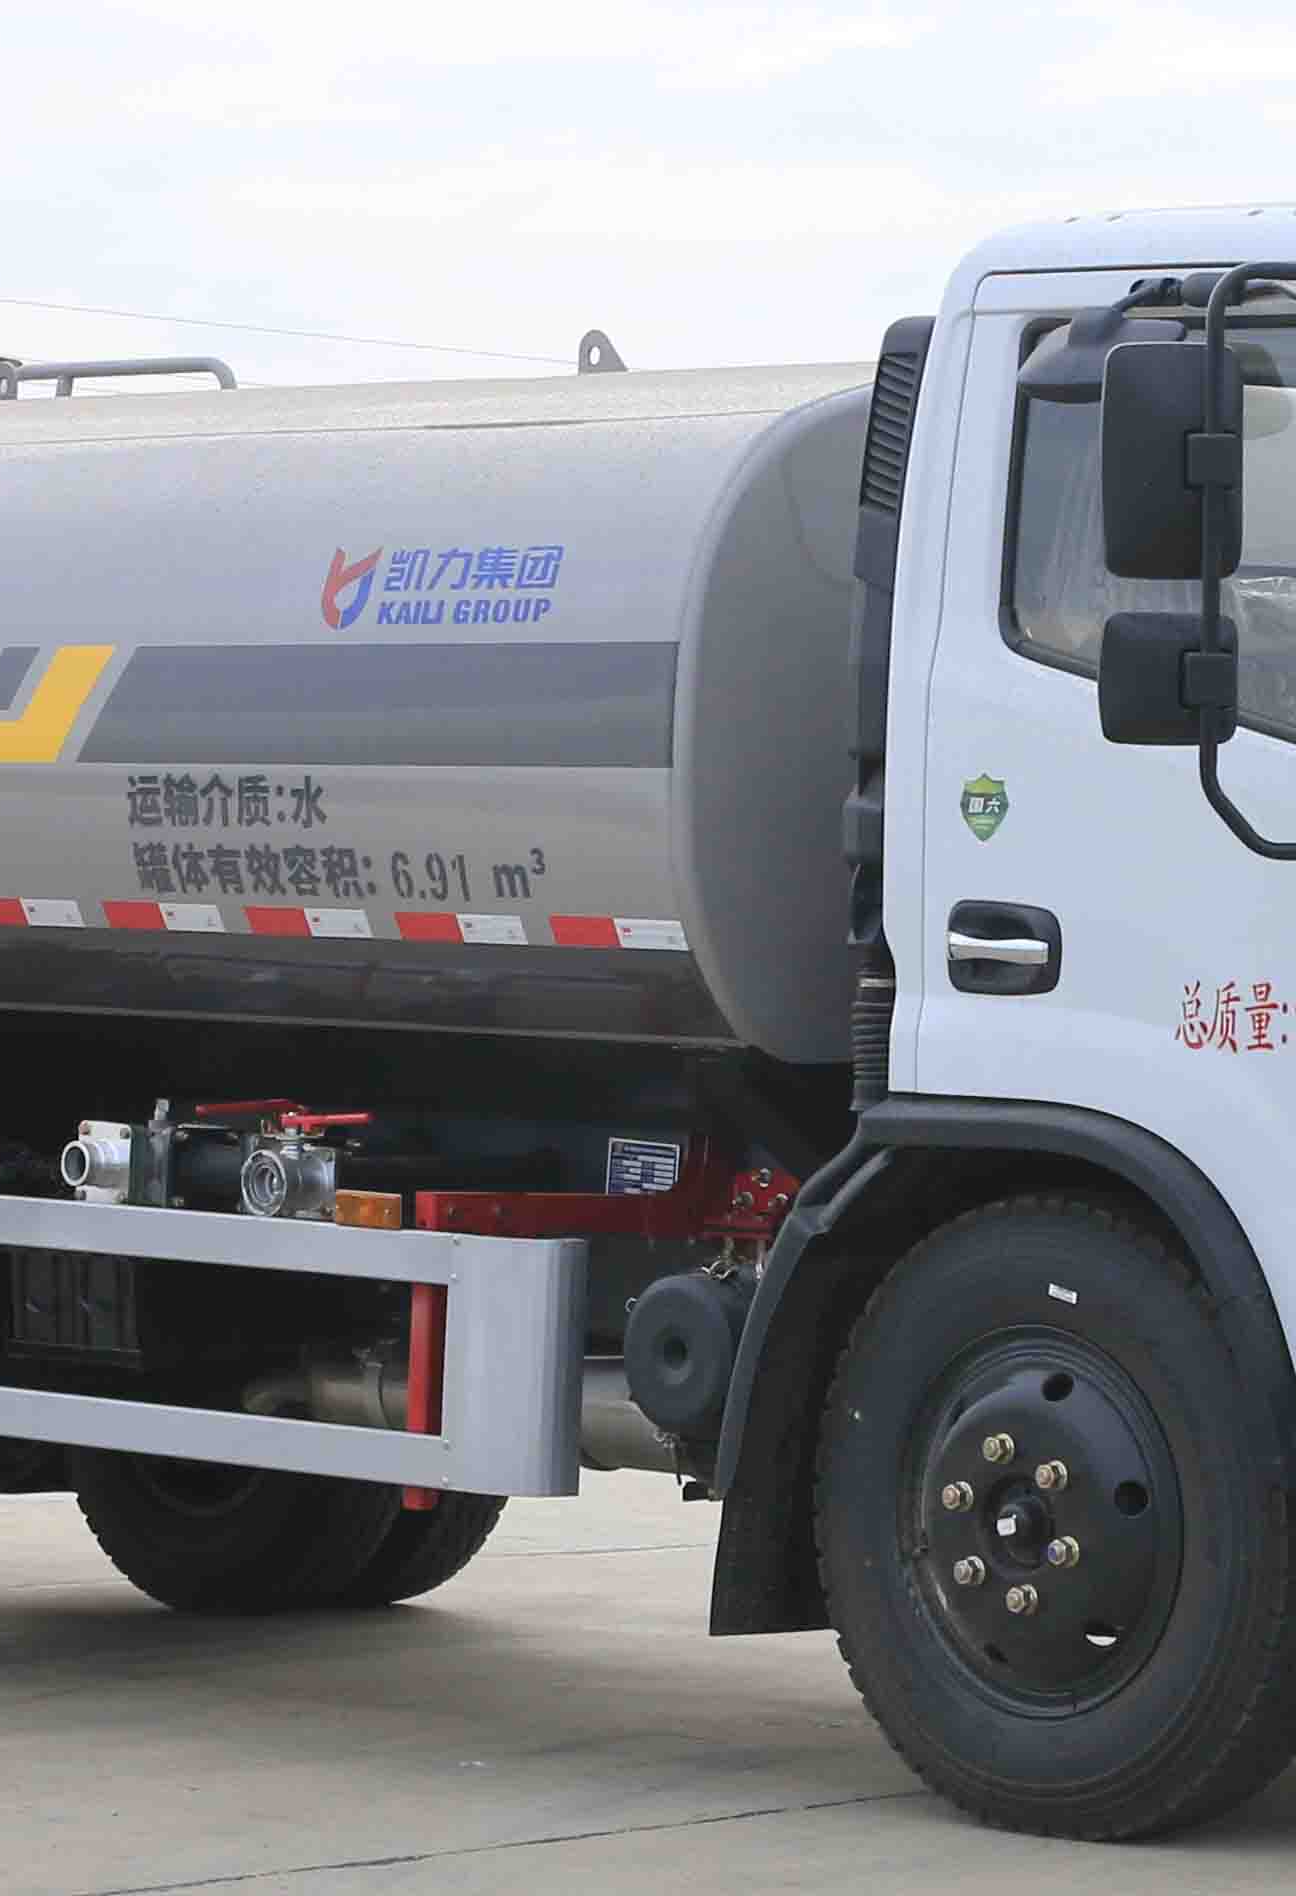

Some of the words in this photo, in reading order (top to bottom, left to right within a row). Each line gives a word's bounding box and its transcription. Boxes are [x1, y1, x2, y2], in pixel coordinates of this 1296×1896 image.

[384, 546, 564, 591] 凯力集团
[377, 600, 444, 624] KAILI
[453, 598, 551, 623] GROUP
[391, 851, 471, 901] 6.91
